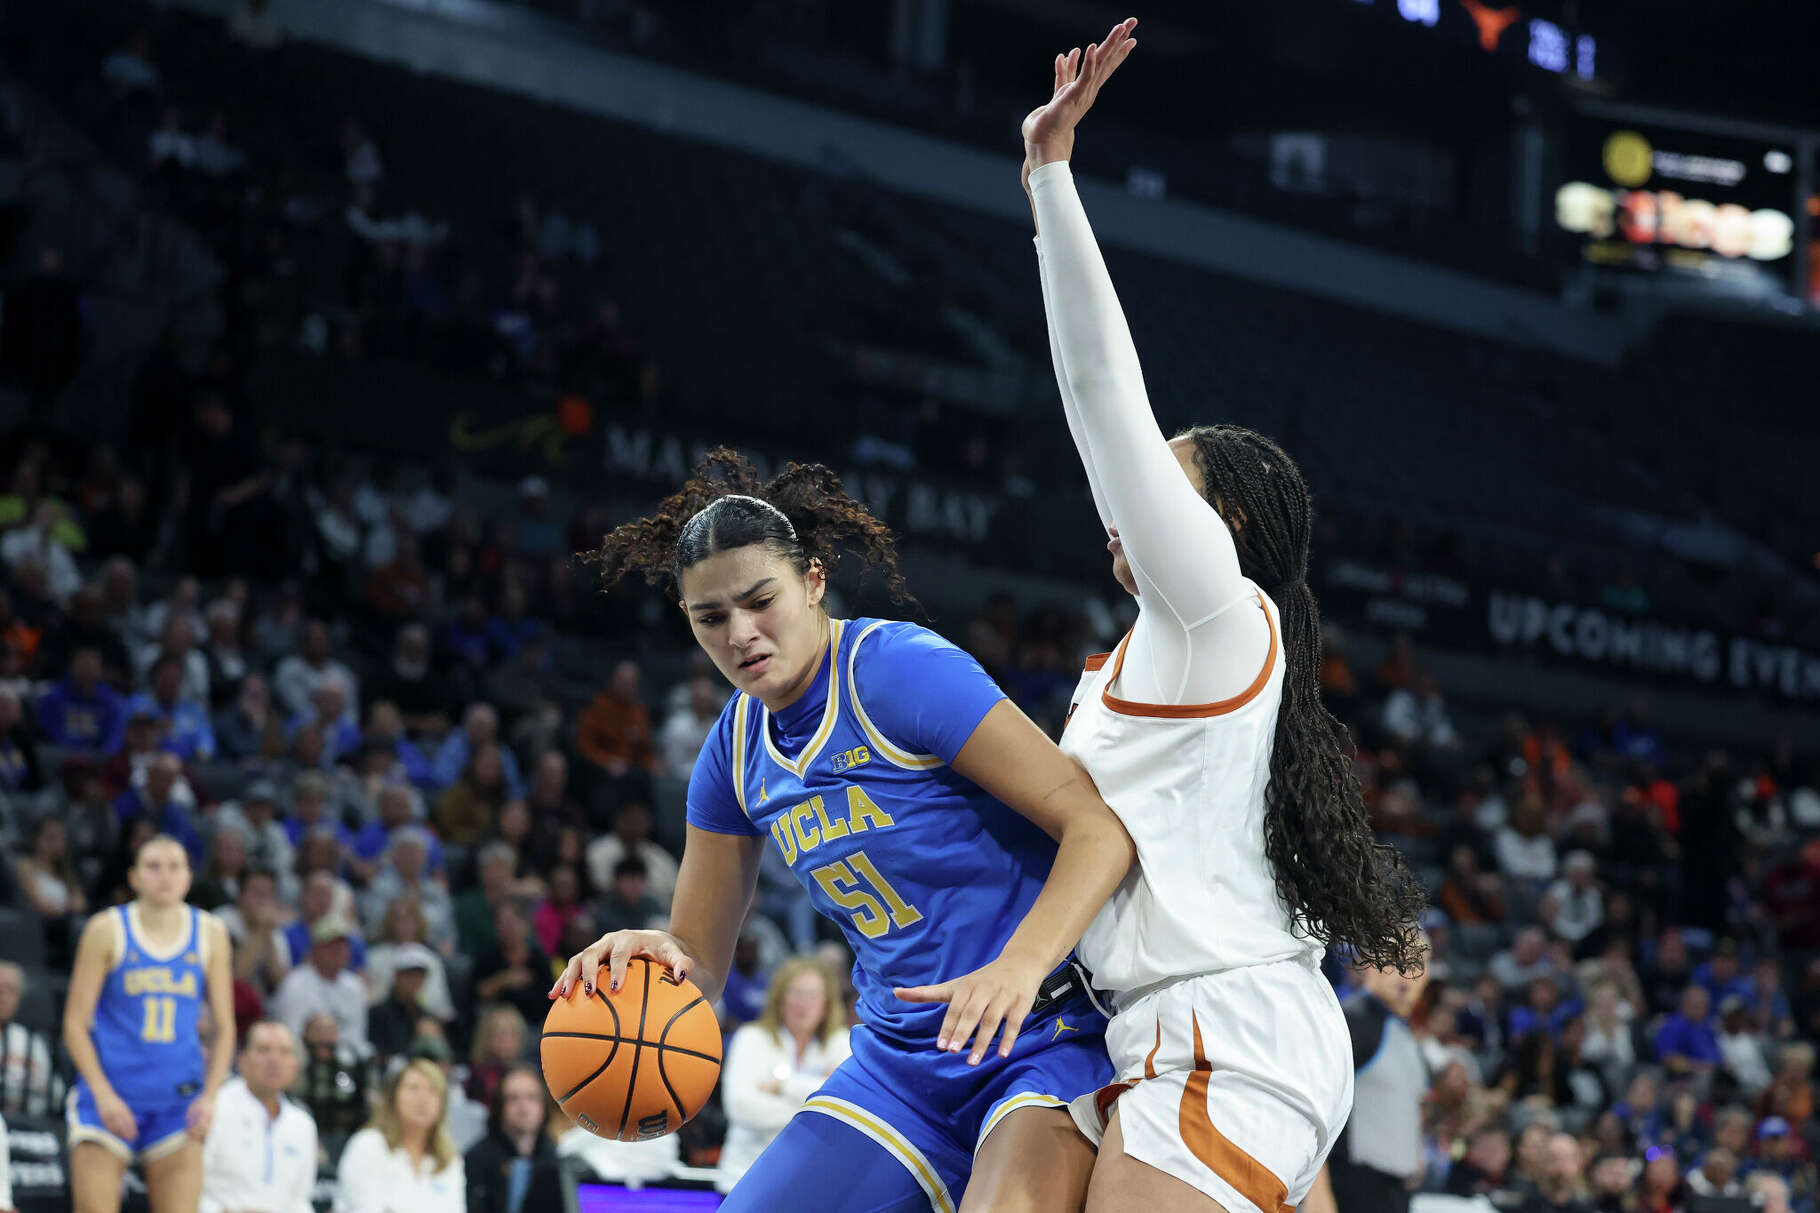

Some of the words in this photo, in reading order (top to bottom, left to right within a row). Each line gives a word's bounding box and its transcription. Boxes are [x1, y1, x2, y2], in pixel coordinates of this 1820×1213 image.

[1488, 590, 1720, 682] UPCOMING
[770, 785, 895, 867] UCLA
[810, 851, 925, 939] 51
[124, 968, 198, 998] UCLA
[142, 998, 175, 1043] 11
